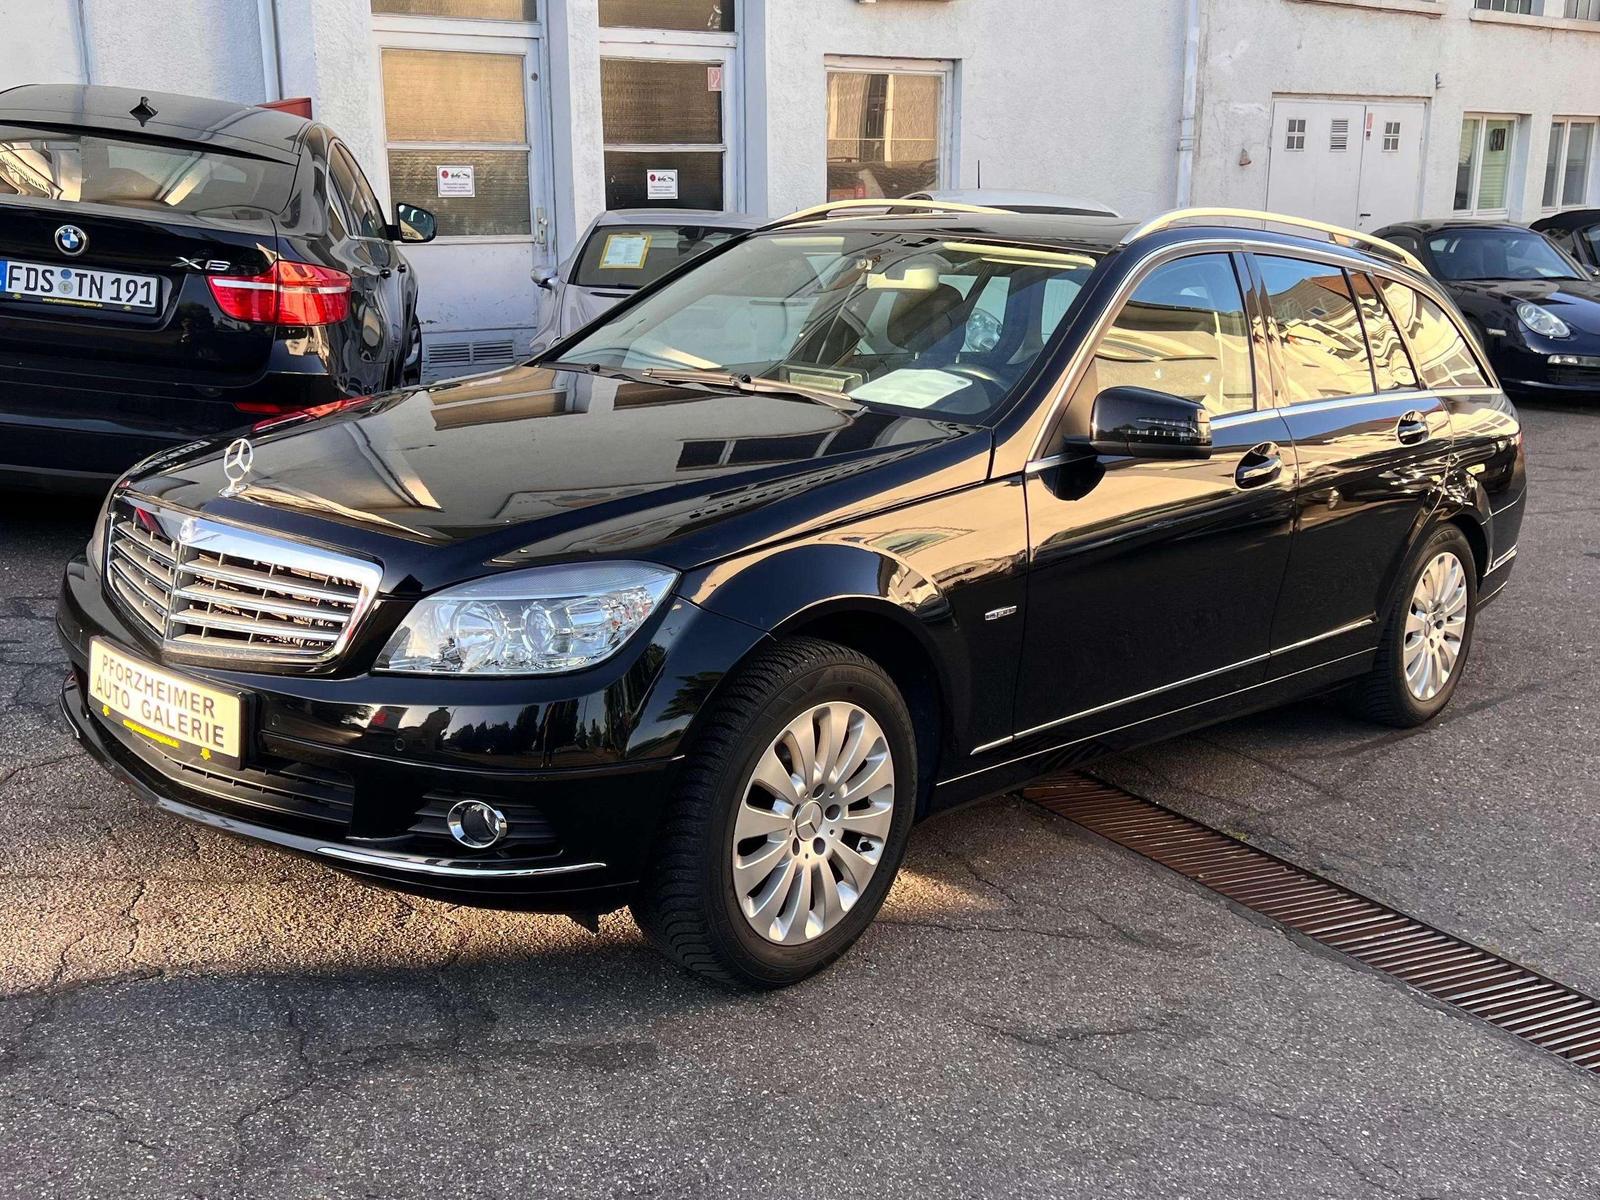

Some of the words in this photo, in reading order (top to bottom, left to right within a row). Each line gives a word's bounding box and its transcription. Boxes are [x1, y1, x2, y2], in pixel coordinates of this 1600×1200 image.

[8, 265, 54, 293] FDS
[75, 272, 104, 299] TN
[109, 278, 153, 305] 191
[95, 675, 130, 710] AUTO
[141, 700, 225, 748] GALERIE
[102, 654, 216, 719] PFORZHEIMER
